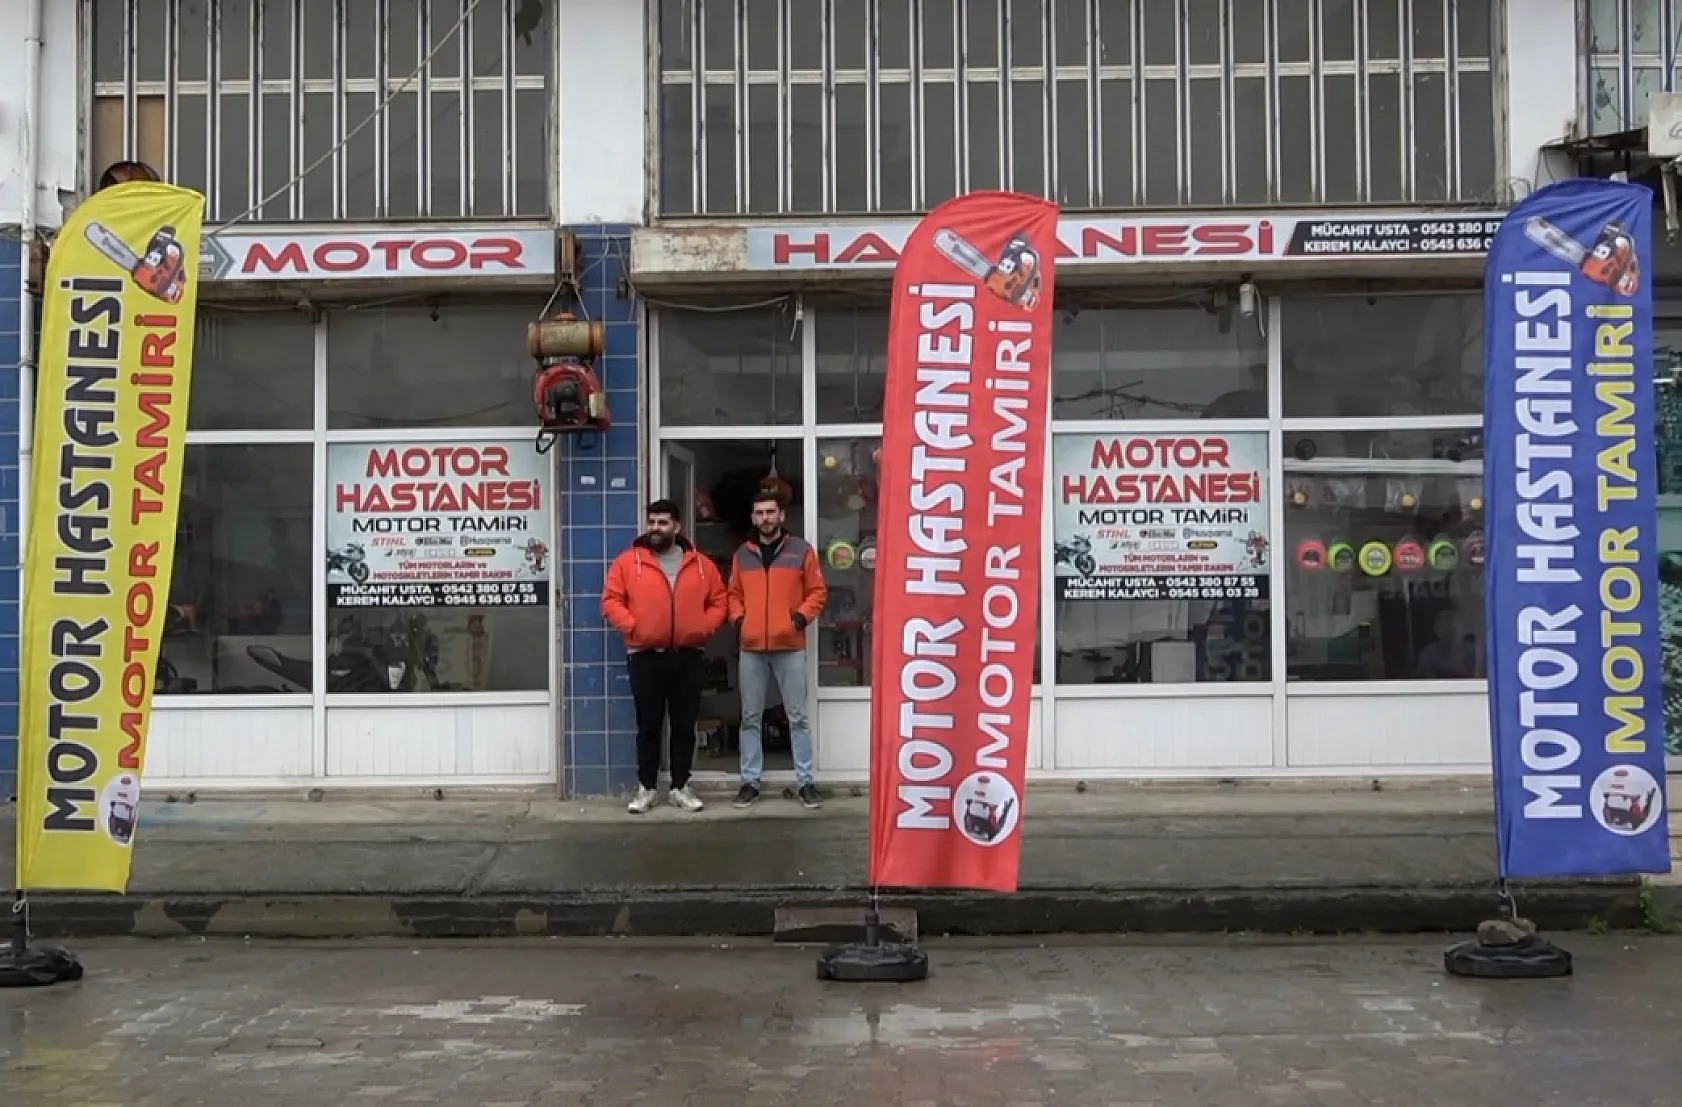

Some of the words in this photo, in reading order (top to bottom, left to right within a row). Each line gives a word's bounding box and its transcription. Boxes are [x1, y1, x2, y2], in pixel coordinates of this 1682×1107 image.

[242, 238, 526, 273] MOTOR
[773, 219, 1273, 263] HANESİ
[1303, 239, 1350, 252] KEREM
[1352, 238, 1410, 251] KALAYCI
[1420, 237, 1454, 250] 0545
[1456, 237, 1482, 250] 636
[1374, 222, 1410, 236] USTA
[1420, 221, 1455, 235] 0542
[1457, 221, 1482, 234] 380
[131, 313, 177, 525] TAMİRİ
[985, 320, 1033, 527] TAMİRİ
[1501, 271, 1582, 583] HASTANESİ
[1585, 303, 1638, 513] TAMİRİ
[53, 277, 124, 595] HASTANESİ
[905, 283, 976, 595] HASTANESİ
[1091, 437, 1230, 468] MOTOR
[366, 446, 511, 478] MOTOR
[336, 478, 541, 512] HASTANESİ
[1062, 471, 1260, 504] HASTANESİ
[352, 516, 440, 532] MOTOR
[448, 515, 527, 532] TAMİRİ
[1079, 509, 1164, 524] MOTOR
[1171, 508, 1248, 524] TAMİRİ
[1096, 529, 1131, 539] STIHL
[336, 596, 379, 606] KEREM
[444, 595, 475, 605] 0545
[401, 585, 431, 595] USTA
[442, 584, 473, 594] 0542
[1064, 588, 1104, 599] KEREM
[1169, 588, 1199, 598] 0545
[1202, 588, 1223, 598] 636
[1226, 588, 1241, 598] 03
[1125, 577, 1156, 587] USTA
[1167, 576, 1196, 587] 0542
[118, 540, 160, 770] MOTOR
[975, 544, 1021, 769] MOTOR
[1599, 525, 1646, 754] MOTOR
[43, 617, 109, 831] MOTOR
[896, 616, 965, 829] MOTOR
[1516, 604, 1584, 819] MOTOR
